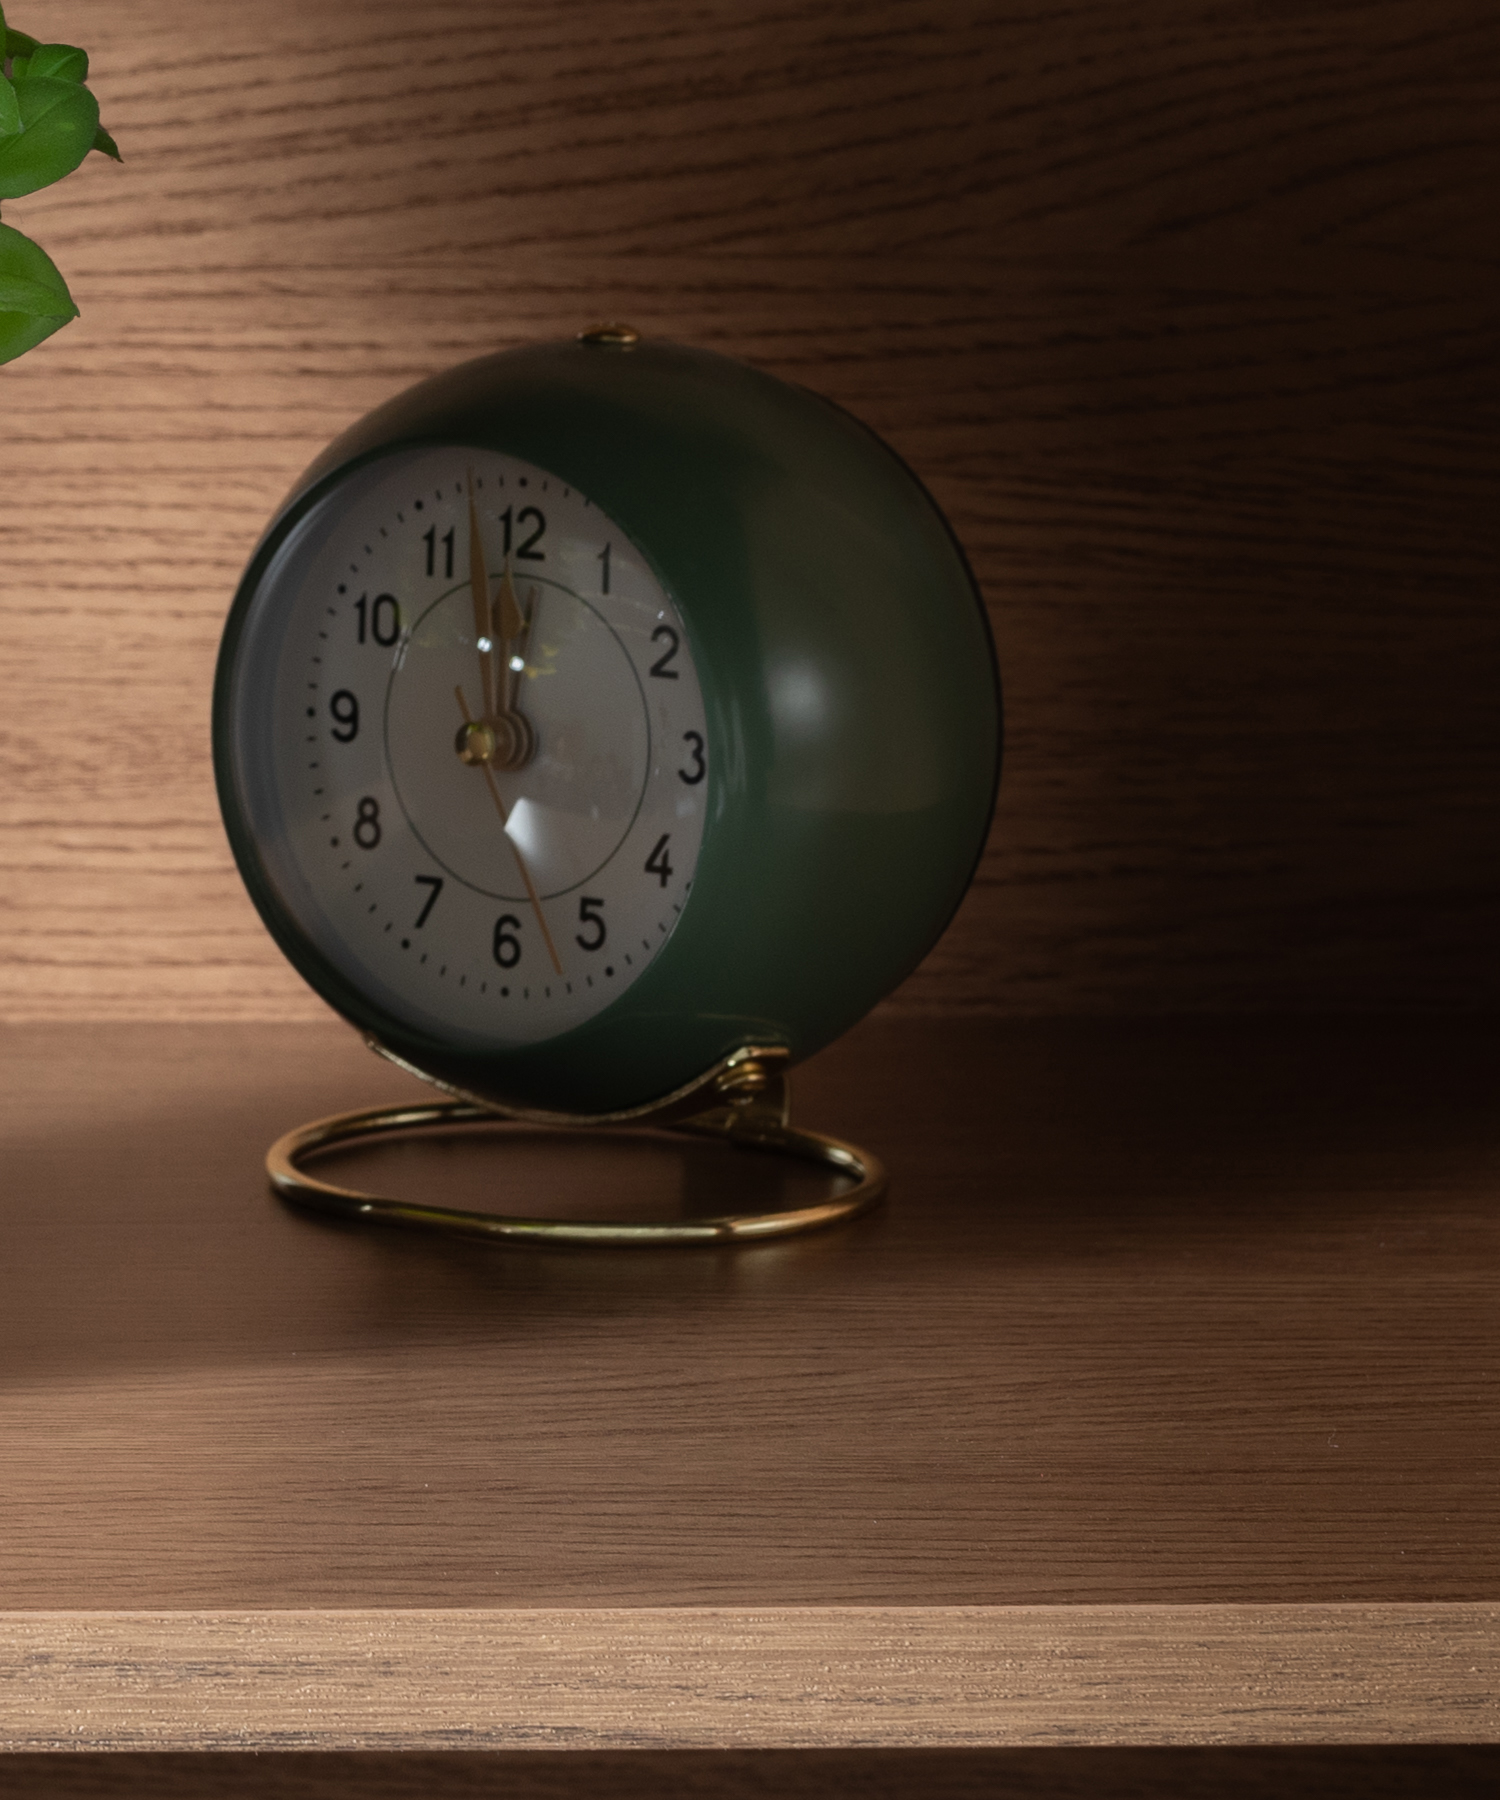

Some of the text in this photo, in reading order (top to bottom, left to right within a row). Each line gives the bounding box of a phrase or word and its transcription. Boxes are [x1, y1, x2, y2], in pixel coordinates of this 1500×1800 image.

[422, 524, 455, 579] 11
[498, 504, 546, 561] 12
[597, 541, 611, 595] 1
[353, 593, 401, 648] 10
[649, 624, 680, 680] 2
[329, 689, 360, 743] 9
[677, 730, 707, 786] 3
[353, 797, 382, 850] 8
[644, 834, 674, 888] 4
[415, 874, 444, 929] 7
[575, 896, 607, 952] 5
[492, 914, 522, 969] 6
